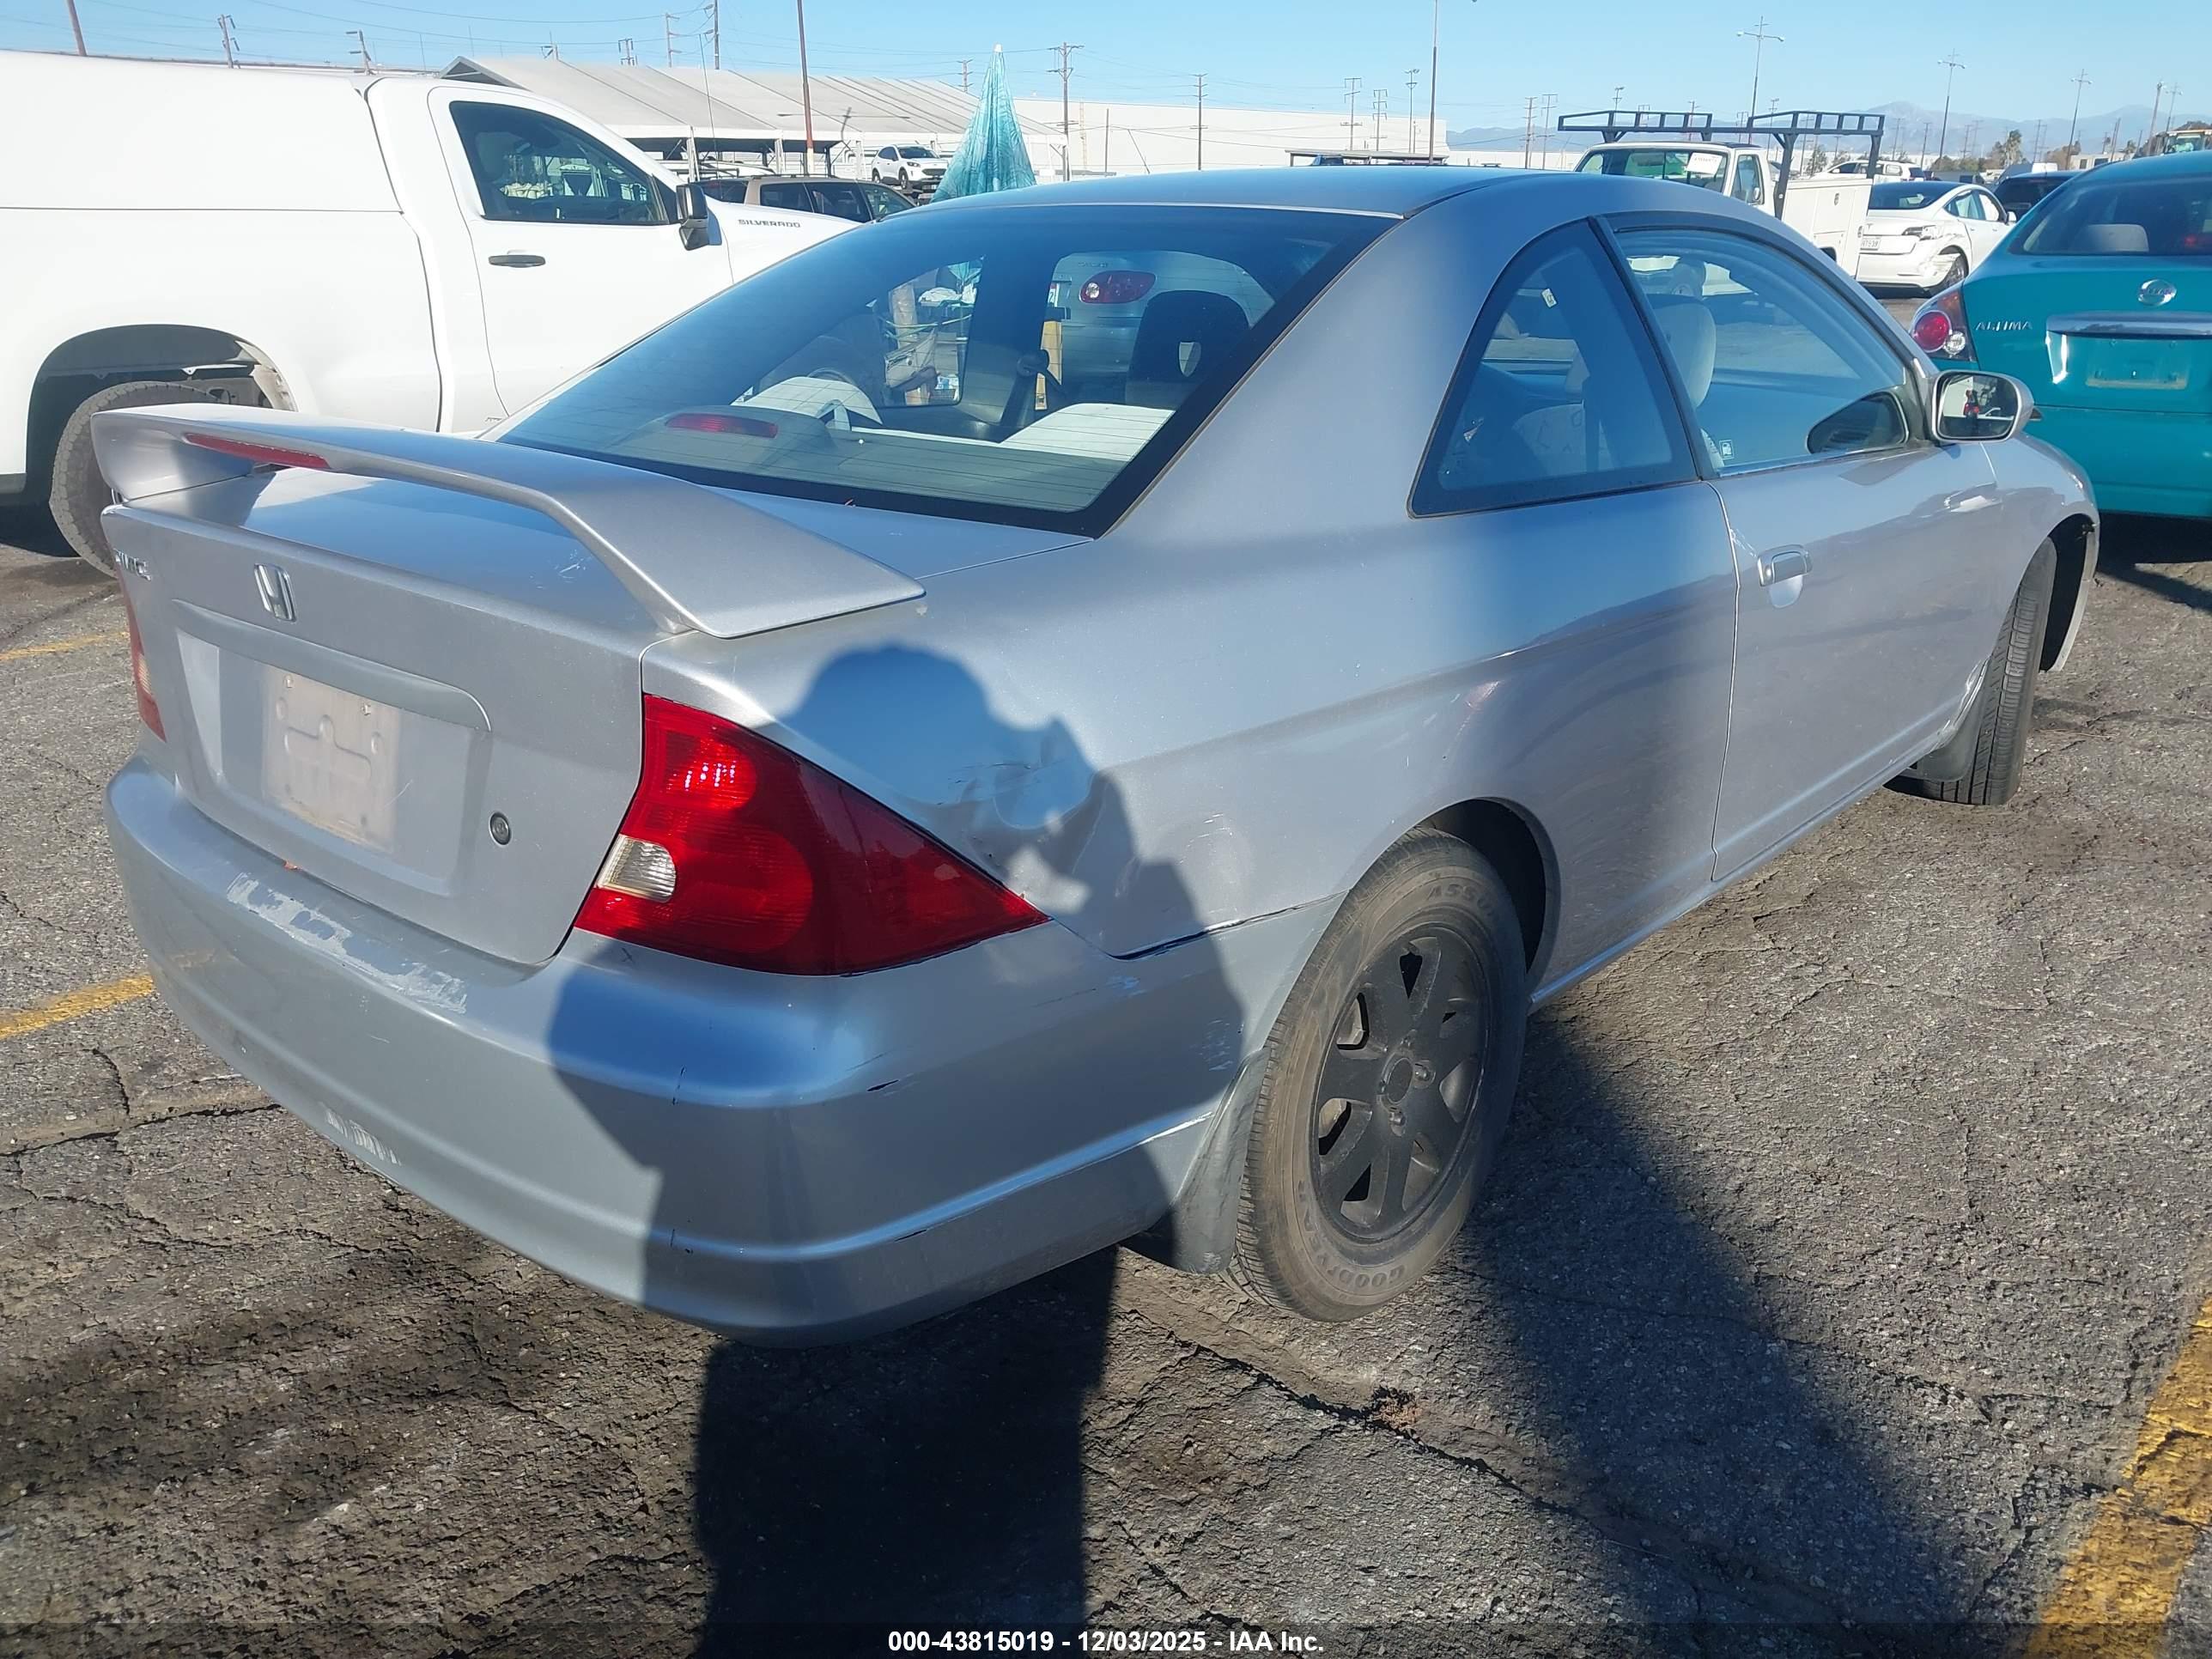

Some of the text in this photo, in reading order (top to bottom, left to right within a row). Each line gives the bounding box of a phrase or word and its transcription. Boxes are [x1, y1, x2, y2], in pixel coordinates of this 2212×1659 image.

[738, 218, 801, 228] SILVERADO
[1975, 320, 2033, 331] ALTIMA
[1297, 1180, 1407, 1289] GOODYEAR
